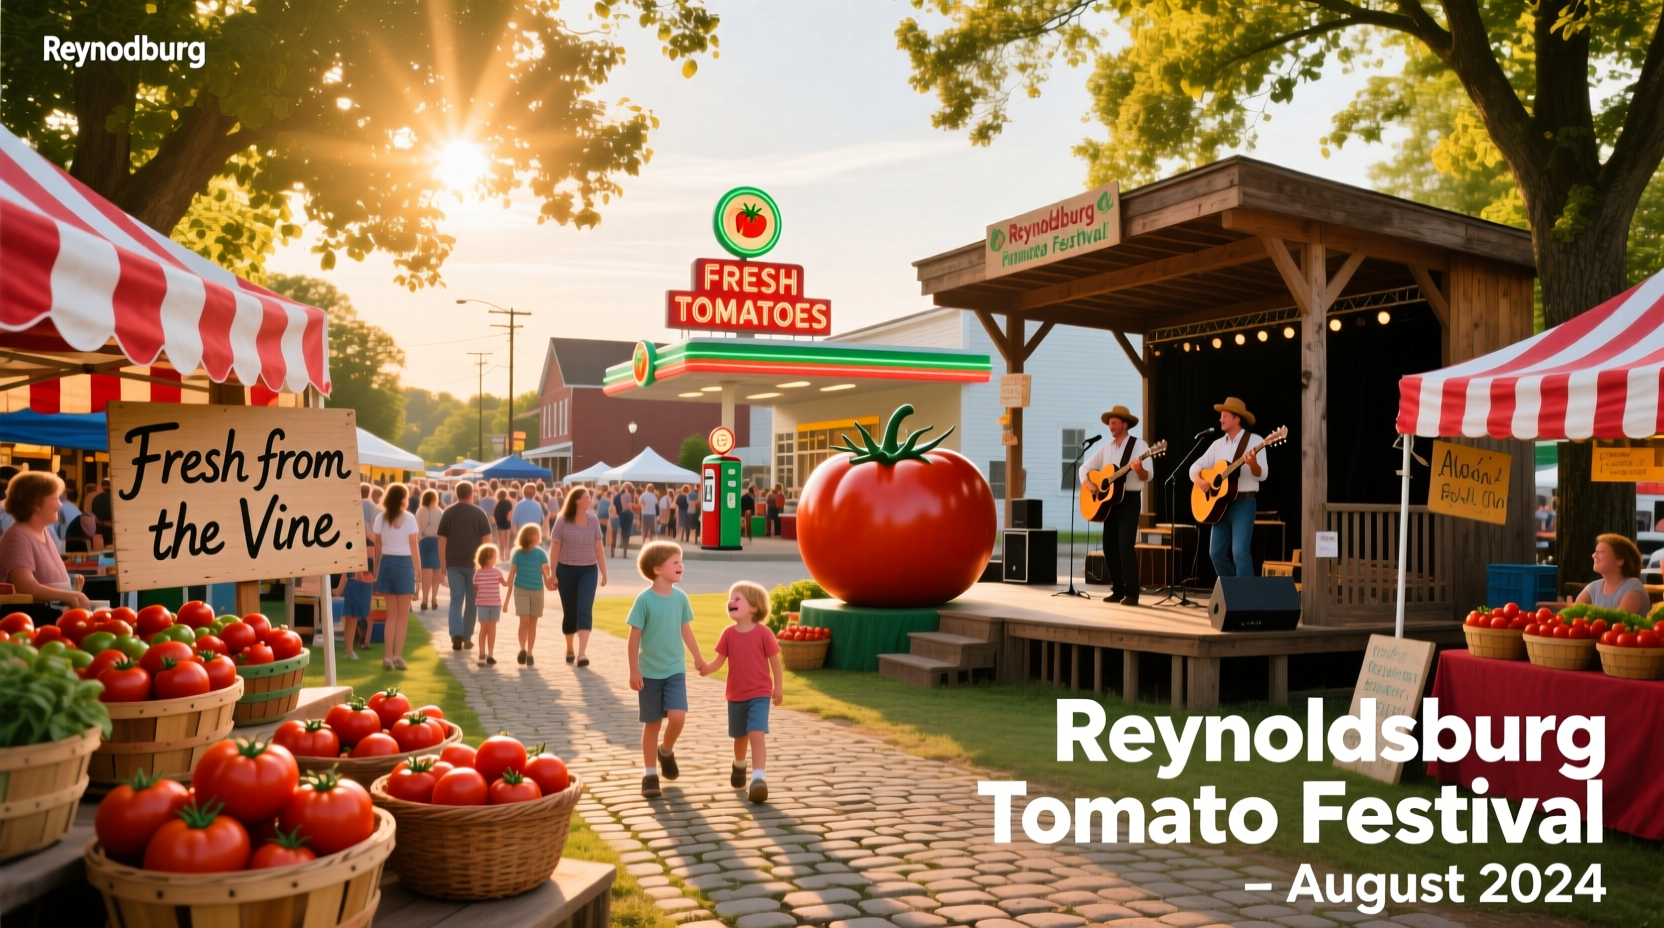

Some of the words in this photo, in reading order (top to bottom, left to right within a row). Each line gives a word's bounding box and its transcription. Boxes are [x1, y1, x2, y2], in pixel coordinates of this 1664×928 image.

[704, 263, 797, 296] FRESH
[674, 296, 827, 329] TOMATOES
[118, 421, 249, 501] Fresh
[253, 428, 352, 492] from
[148, 501, 225, 561] the
[239, 494, 353, 559] Vine.
